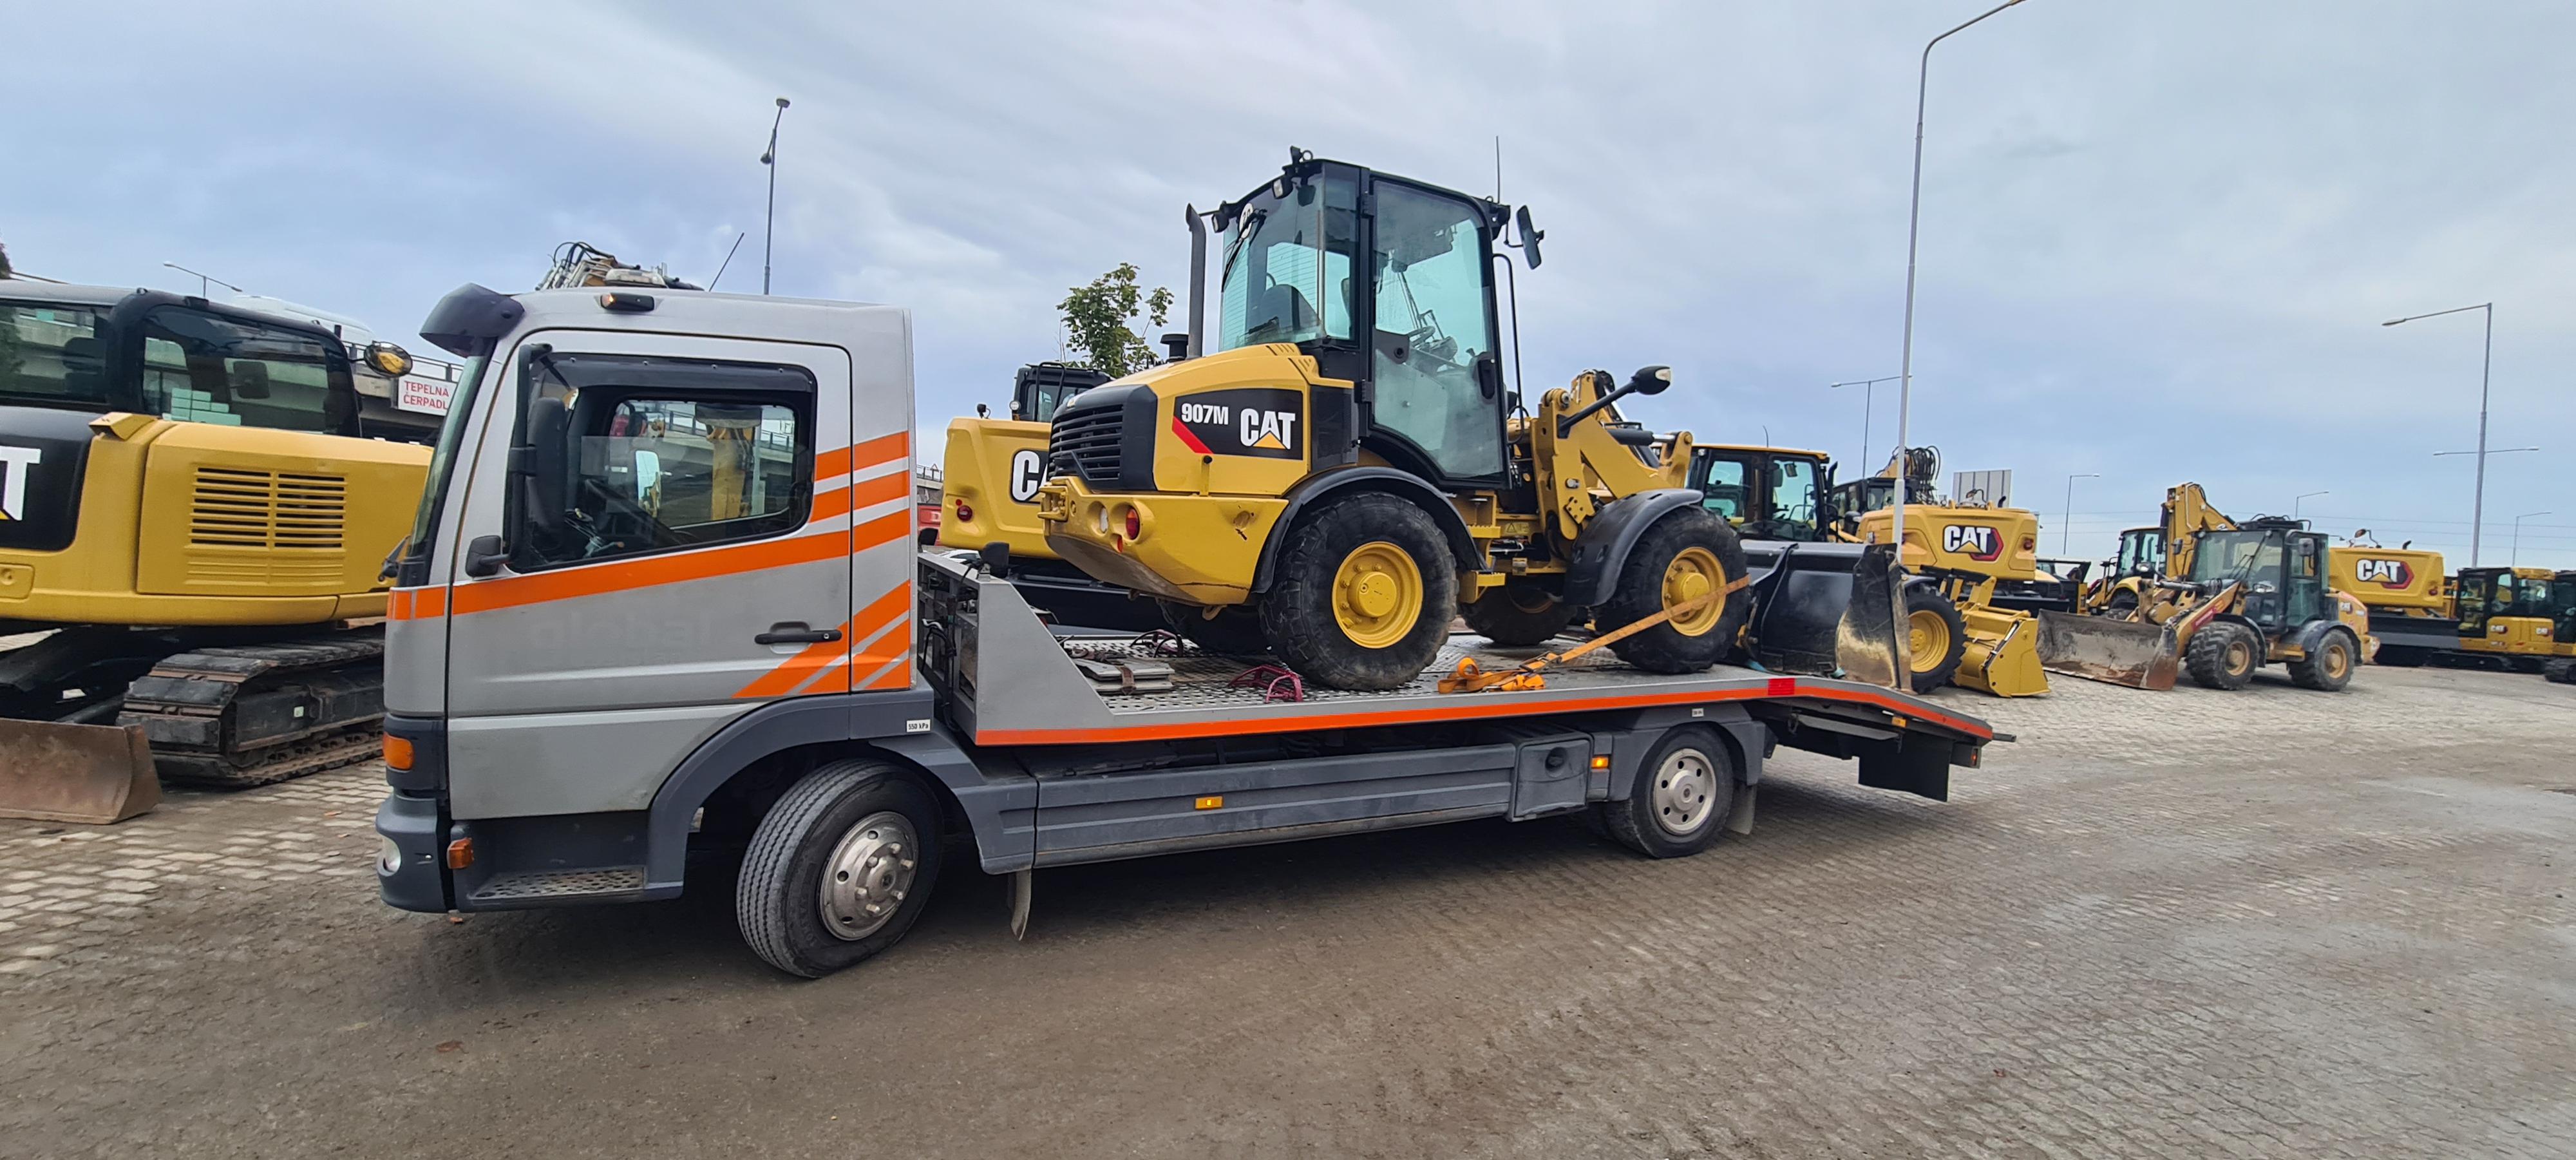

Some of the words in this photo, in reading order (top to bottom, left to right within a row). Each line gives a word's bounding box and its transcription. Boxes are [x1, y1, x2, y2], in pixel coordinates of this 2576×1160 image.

[1181, 403, 1229, 425] 907M
[1240, 408, 1296, 450] CAT
[1012, 450, 1048, 501] C
[1944, 526, 1991, 553] CAT
[2357, 559, 2401, 583] CAT
